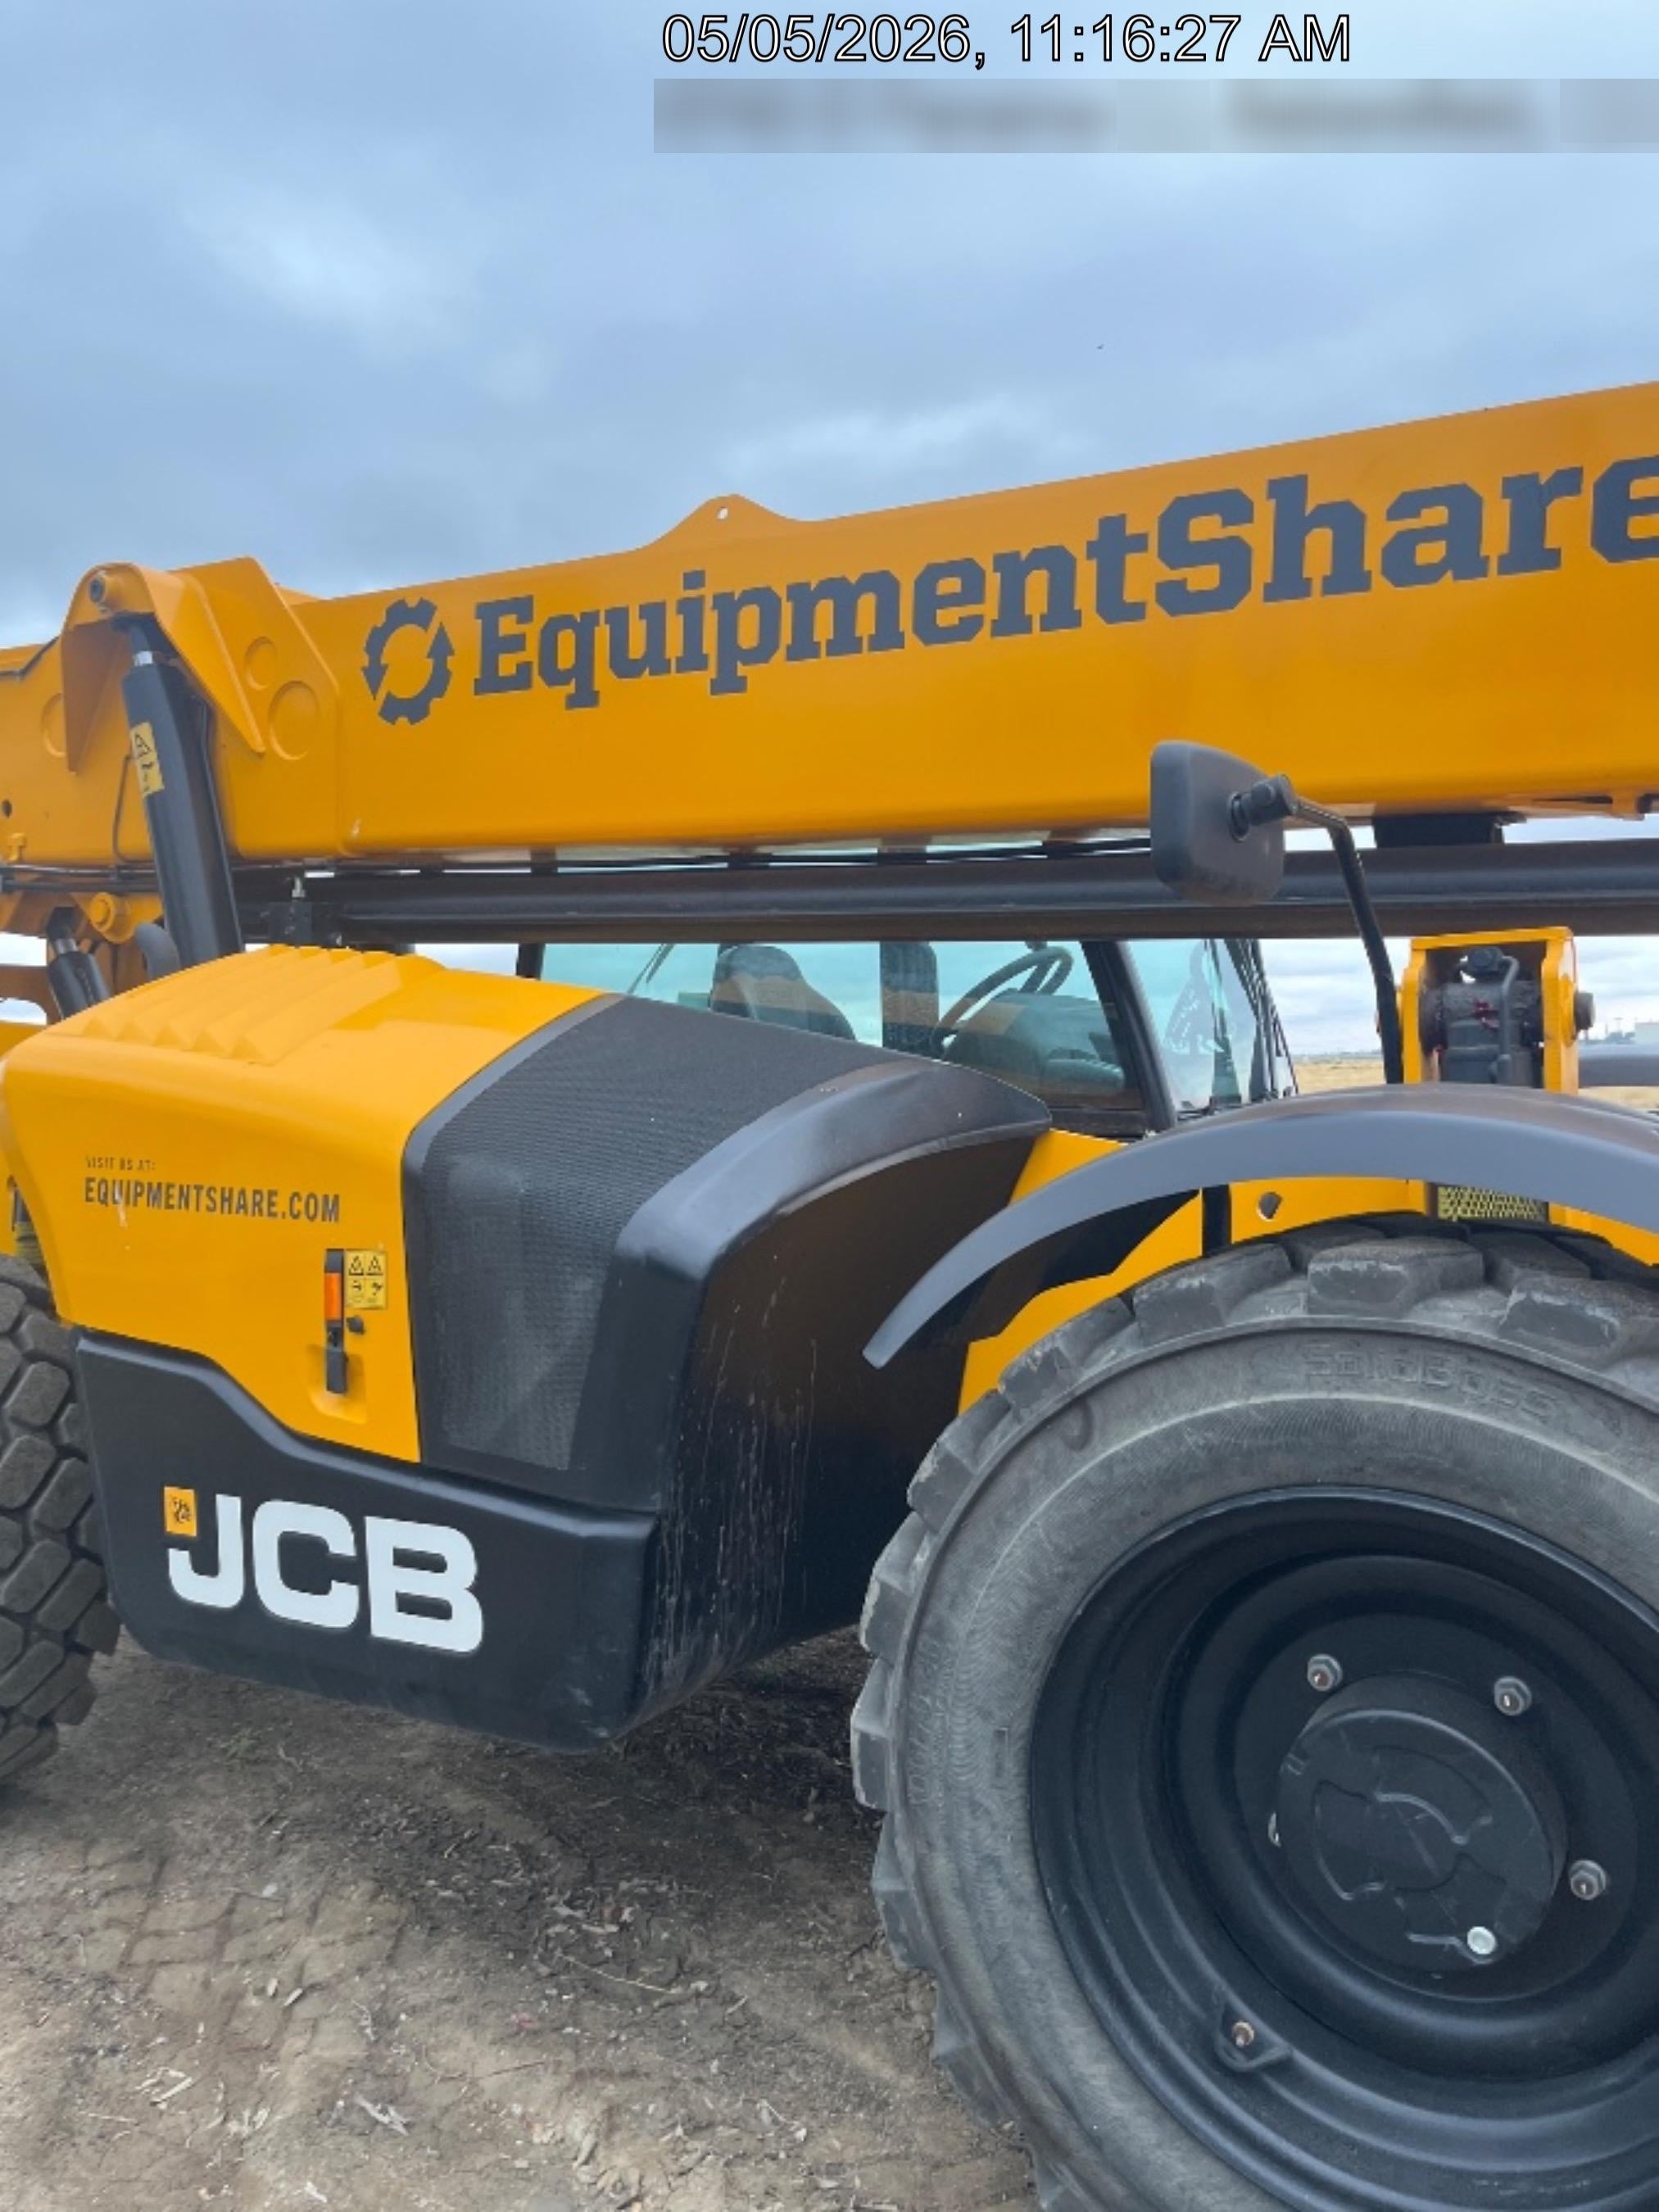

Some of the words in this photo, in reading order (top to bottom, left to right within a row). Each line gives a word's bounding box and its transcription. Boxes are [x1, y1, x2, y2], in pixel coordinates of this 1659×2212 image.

[474, 456, 1659, 708] EquipmentShare
[84, 1176, 341, 1222] EQUIPMENTSHARE.COM
[168, 1494, 483, 1653] JCB
